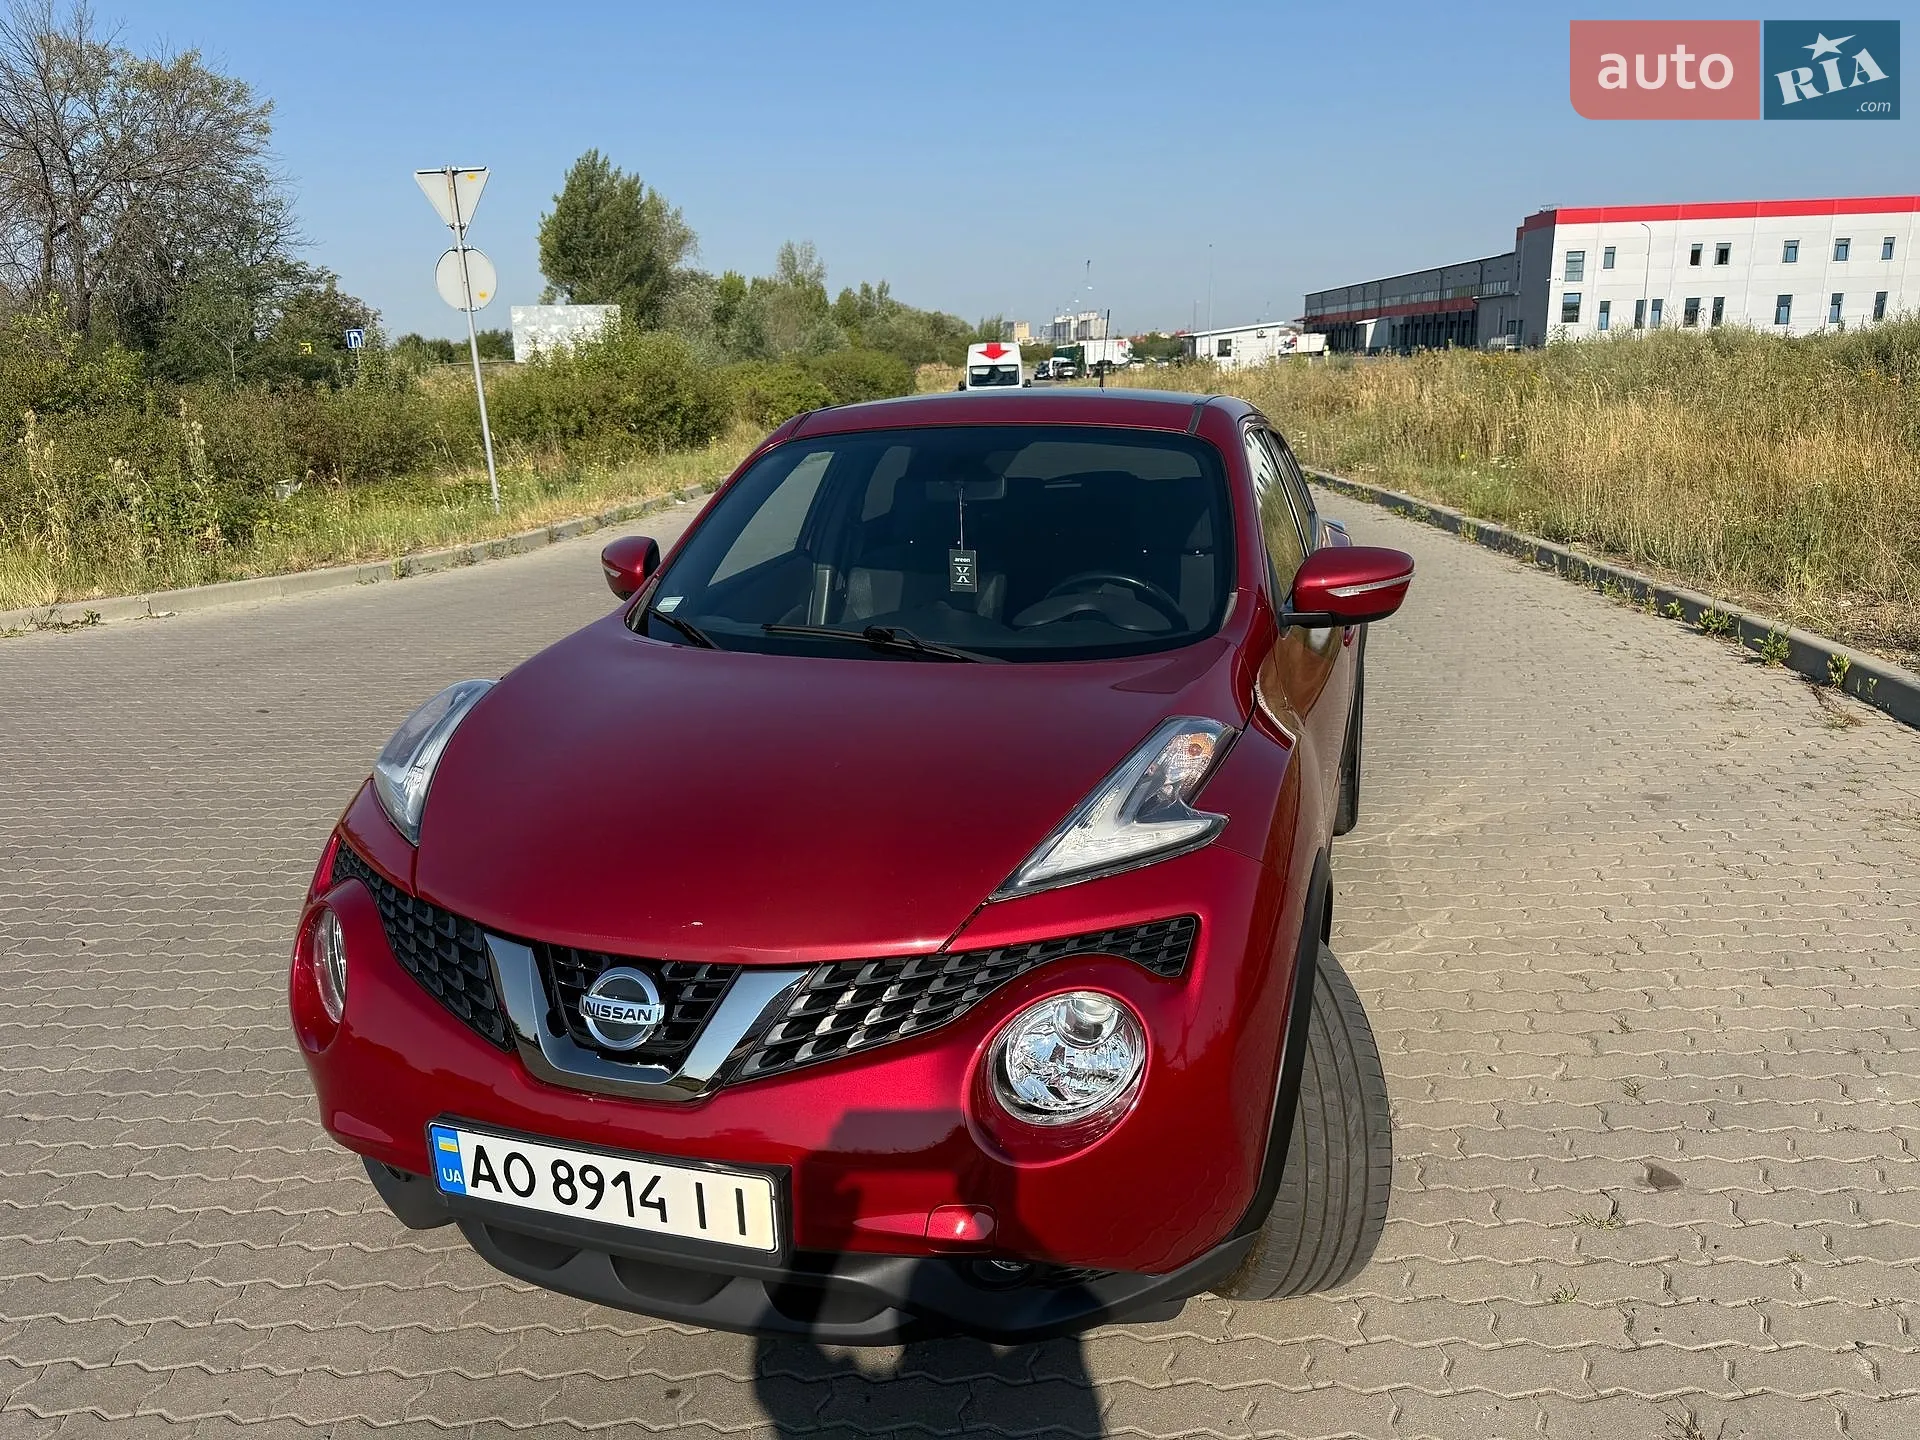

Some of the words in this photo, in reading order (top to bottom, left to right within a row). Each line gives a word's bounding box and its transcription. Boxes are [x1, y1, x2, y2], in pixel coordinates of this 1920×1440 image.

[585, 1001, 652, 1022] NISSAN
[443, 1167, 464, 1185] UA
[471, 1145, 535, 1198] AO
[550, 1159, 668, 1224] 8914
